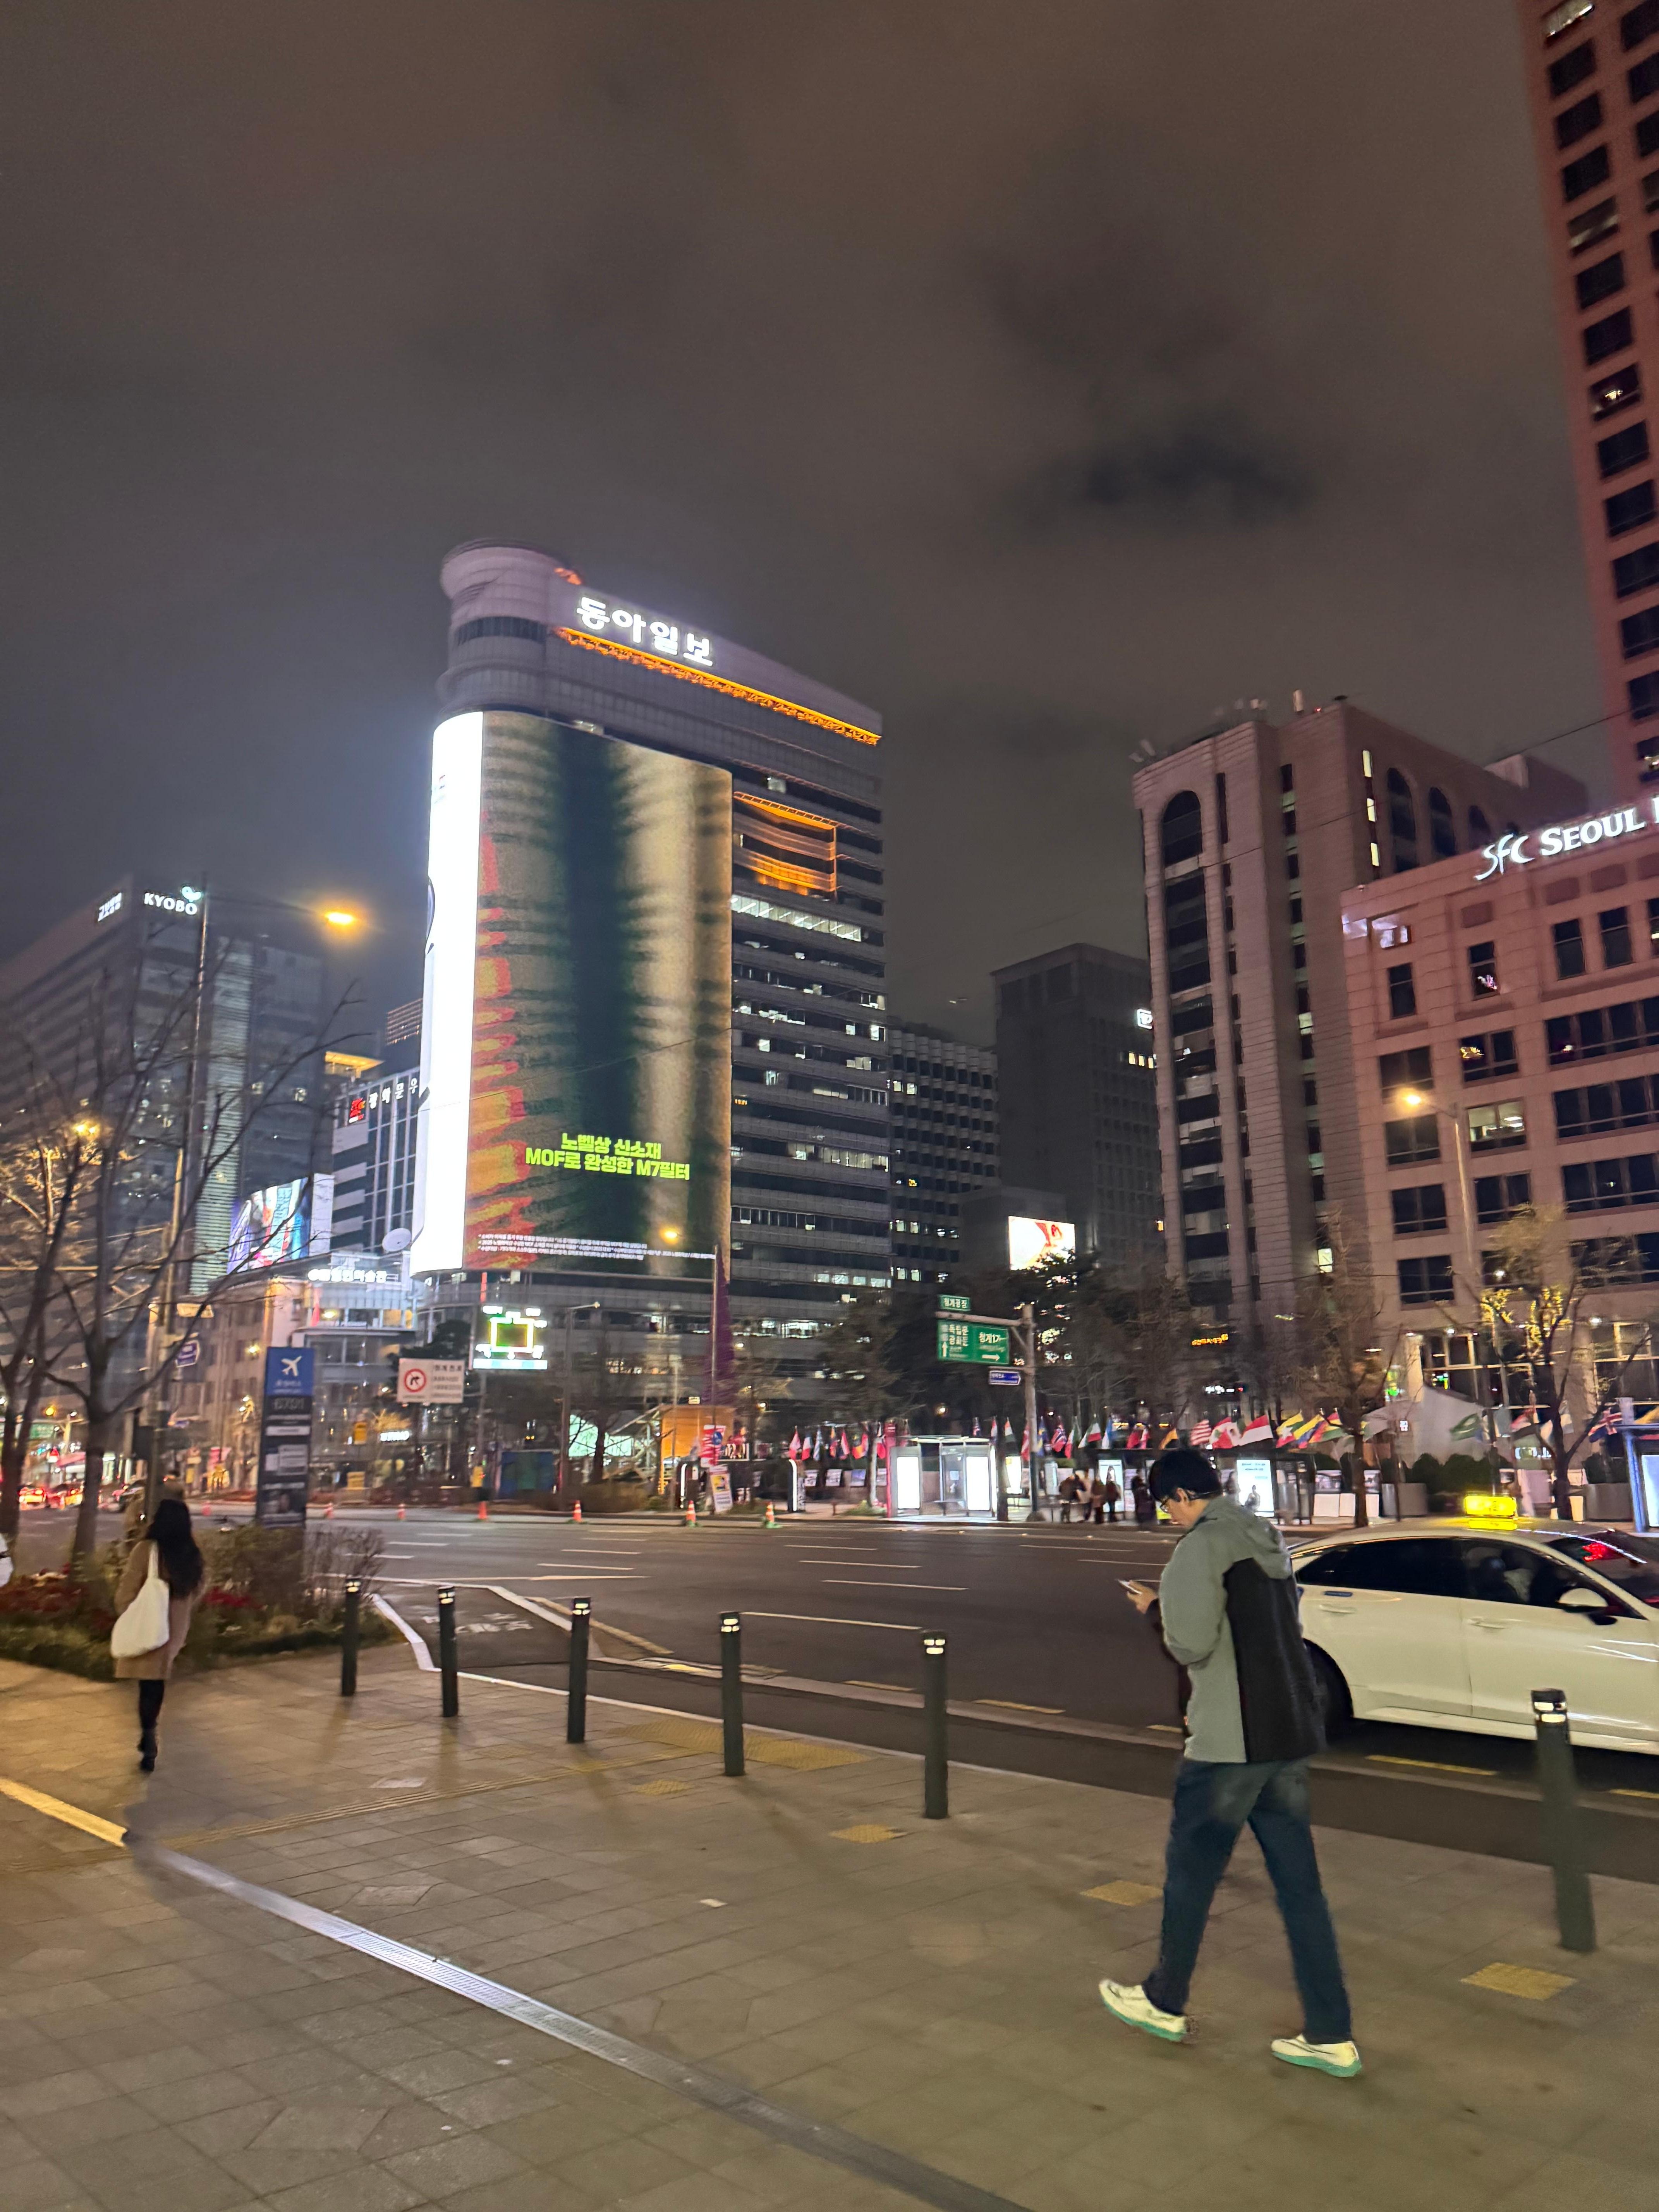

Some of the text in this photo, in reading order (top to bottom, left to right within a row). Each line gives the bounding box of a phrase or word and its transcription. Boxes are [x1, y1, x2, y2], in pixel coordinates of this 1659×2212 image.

[576, 597, 713, 666] 동아일보
[1540, 808, 1646, 856] SEOUL
[144, 892, 198, 915] KYOBO
[561, 1133, 661, 1159] 노벨상 신소재
[525, 1147, 690, 1180] MOF로 완성한 M7필터
